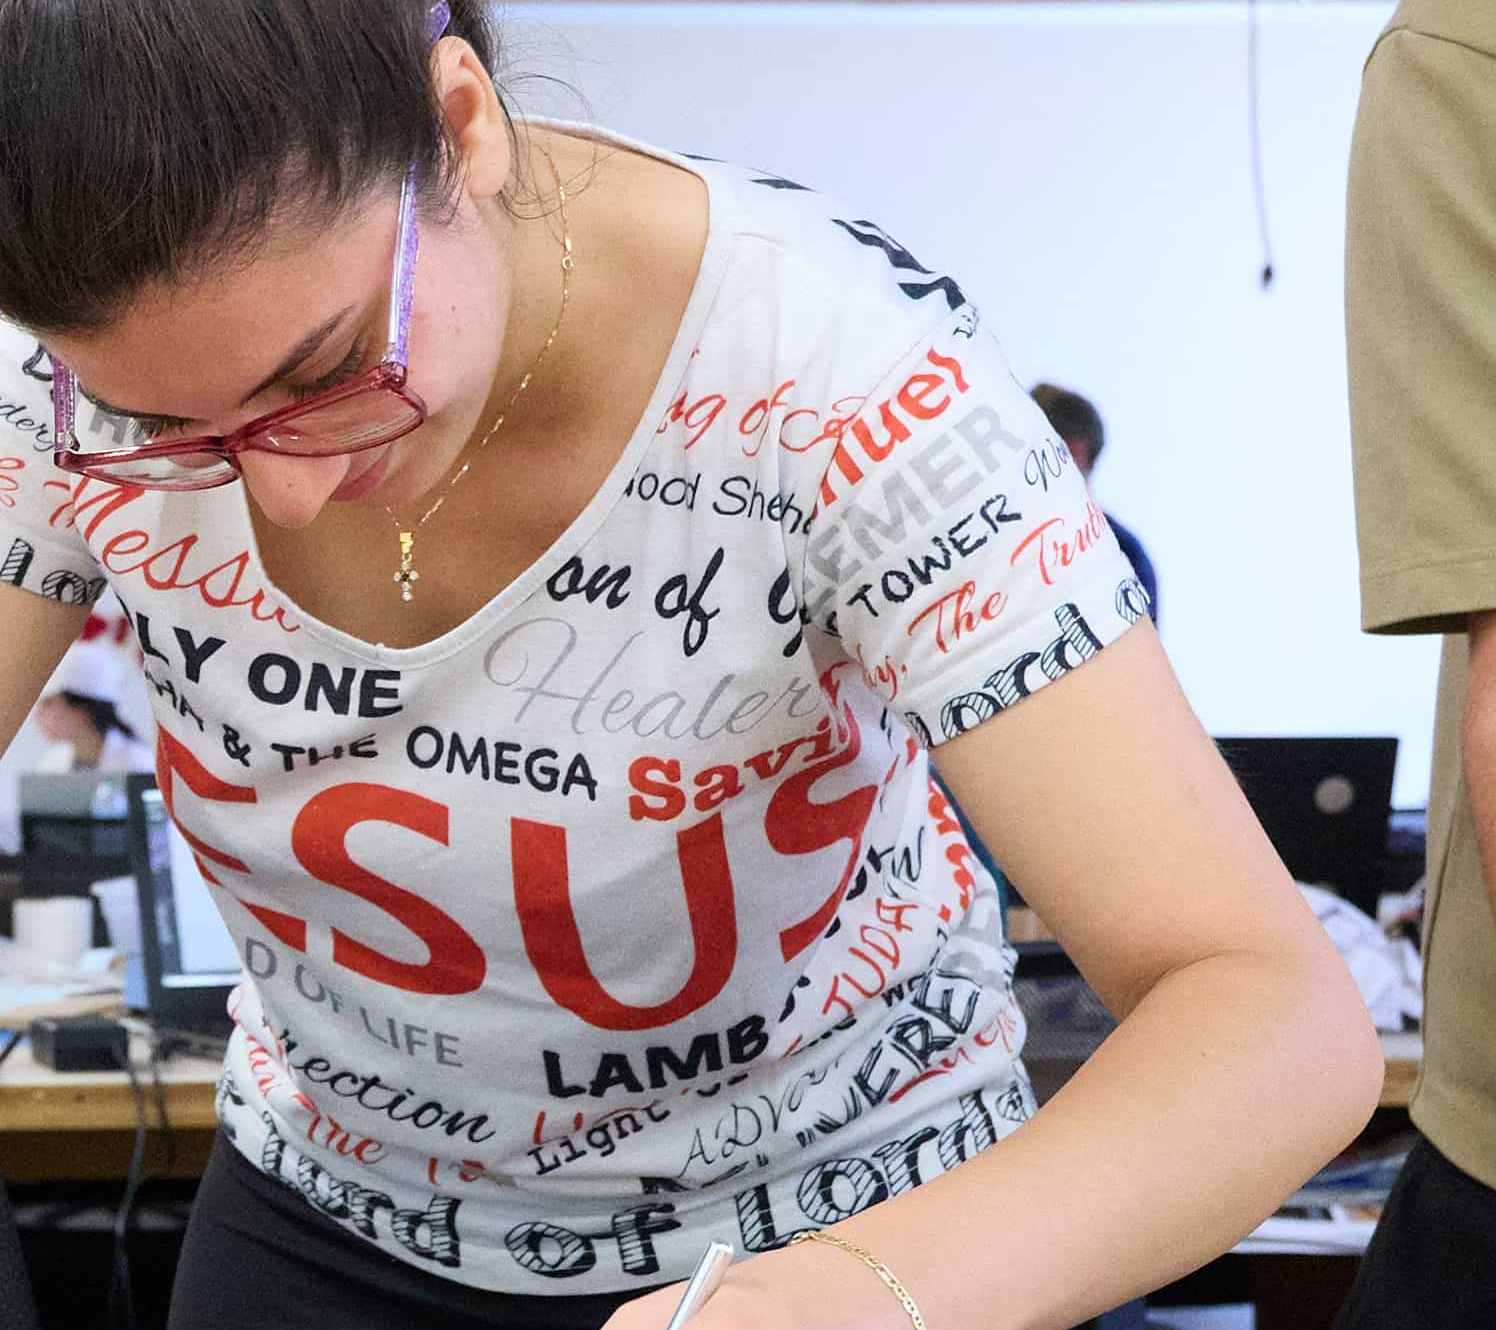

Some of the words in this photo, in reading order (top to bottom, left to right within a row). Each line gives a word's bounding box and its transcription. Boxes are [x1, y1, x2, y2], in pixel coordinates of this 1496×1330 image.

[623, 469, 701, 511] ood
[846, 494, 1022, 618] TOWER
[654, 547, 725, 658] of
[908, 580, 1008, 654] The
[116, 600, 226, 684] LY
[248, 651, 403, 719] ONE
[482, 617, 821, 743] Healer
[407, 725, 598, 801] OMEGA
[359, 1006, 465, 1069] LIFE
[542, 1014, 770, 1099] LAMB
[504, 1202, 682, 1278] of
